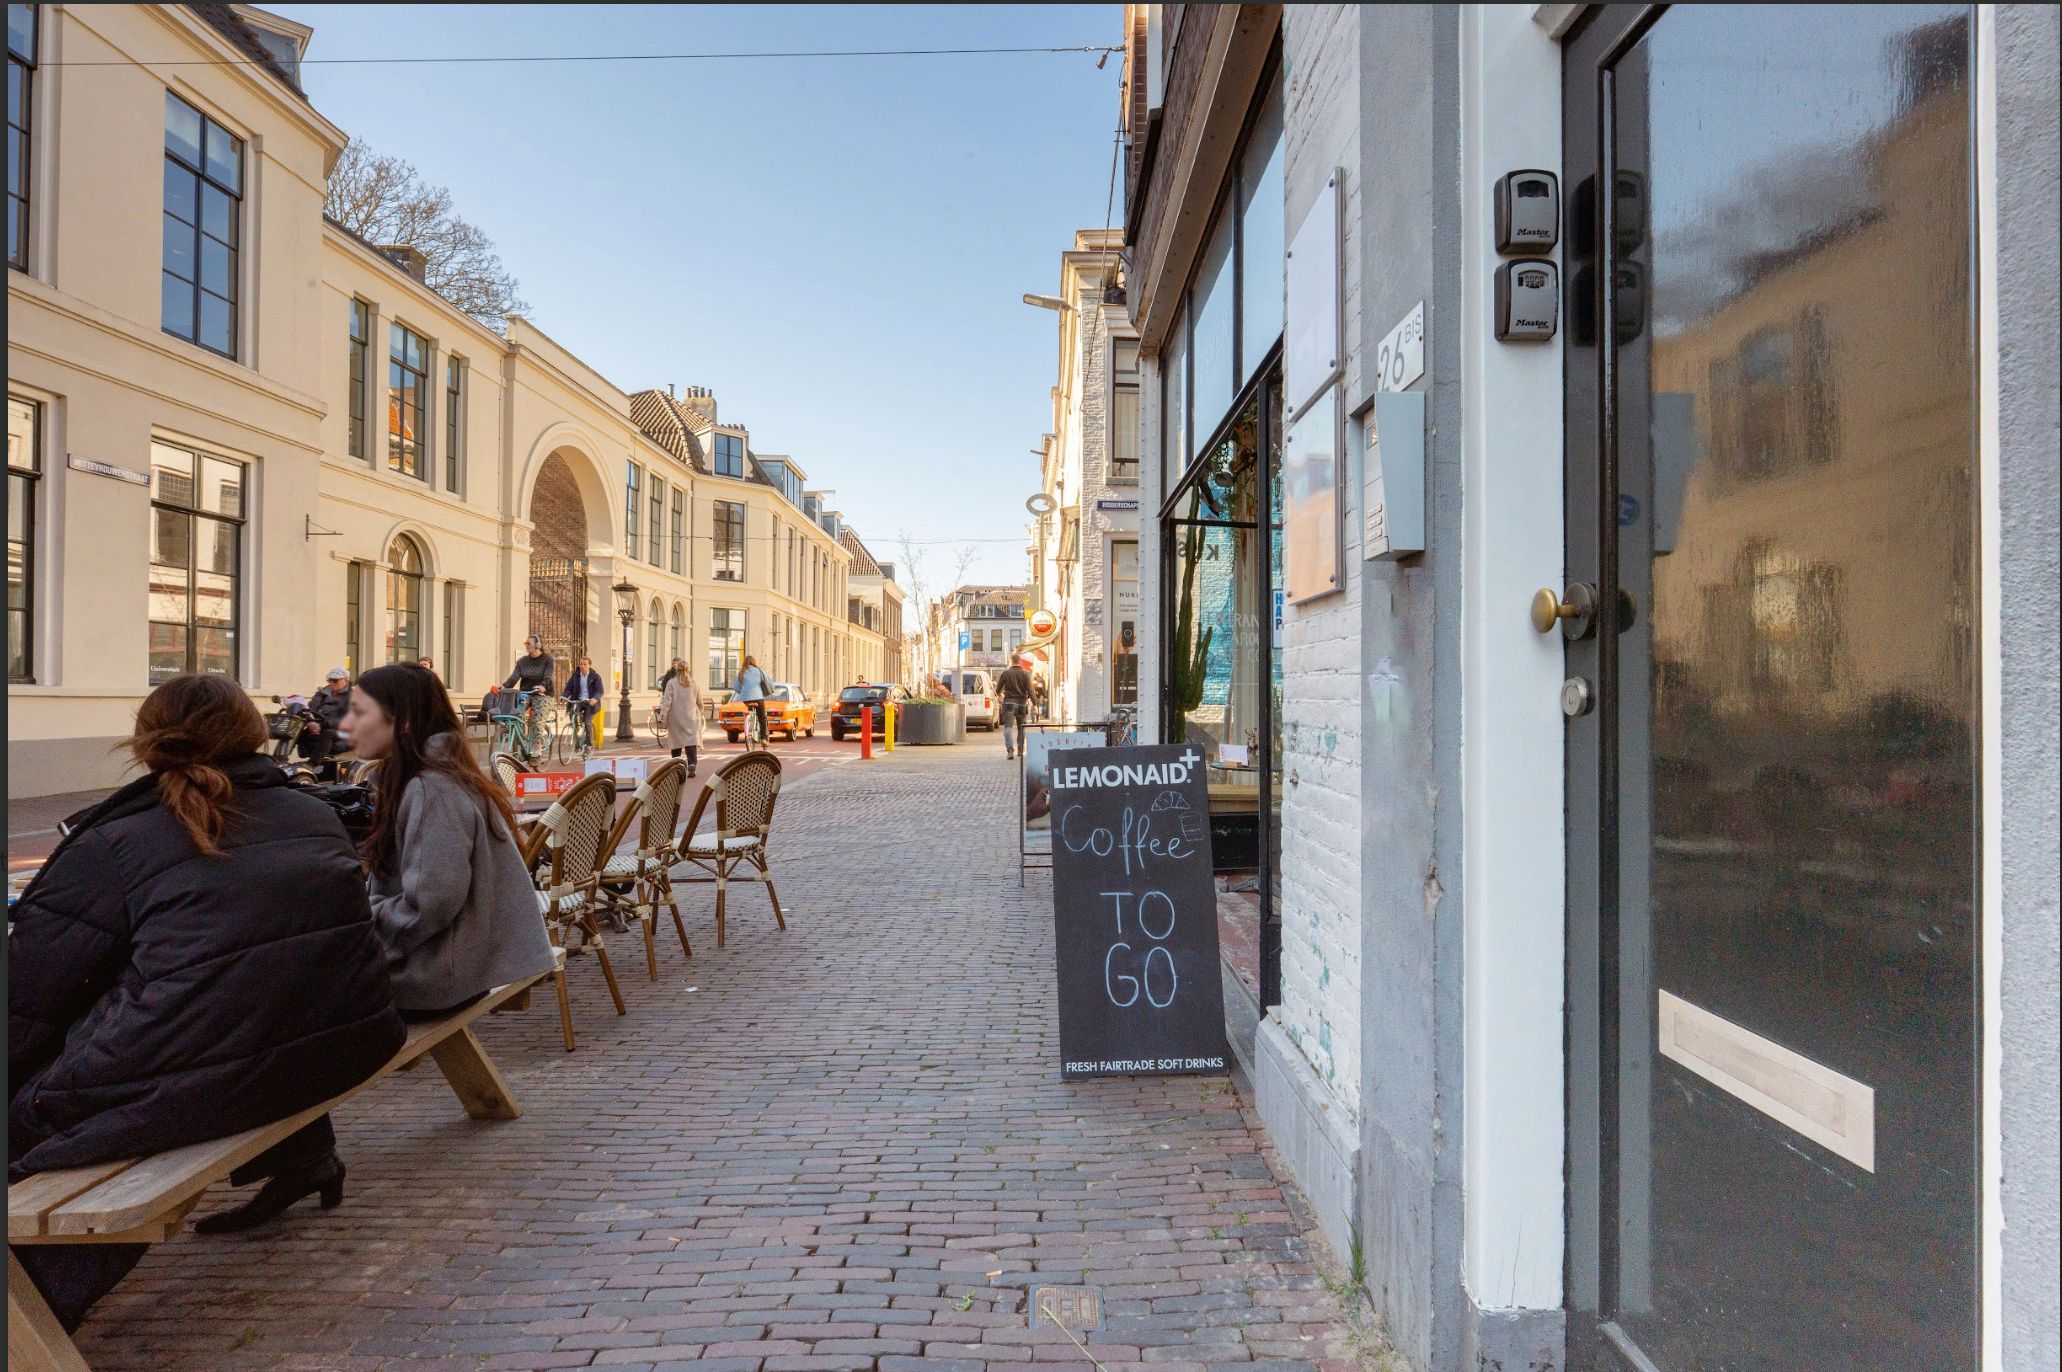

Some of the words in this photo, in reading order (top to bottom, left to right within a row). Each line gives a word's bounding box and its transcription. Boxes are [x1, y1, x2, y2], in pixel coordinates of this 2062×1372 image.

[1516, 227, 1550, 236] Master
[1515, 319, 1549, 327] Master
[1381, 330, 1405, 392] 26
[1405, 313, 1422, 344] BIS
[1061, 804, 1195, 875] Coffee
[1100, 890, 1175, 940] TO
[1105, 942, 1178, 1008] GO
[1066, 1061, 1098, 1073] FRESH
[1100, 1059, 1155, 1072] FAIRTRADE
[1157, 1058, 1184, 1070] SOFT
[1185, 1057, 1224, 1069] DRINKS
